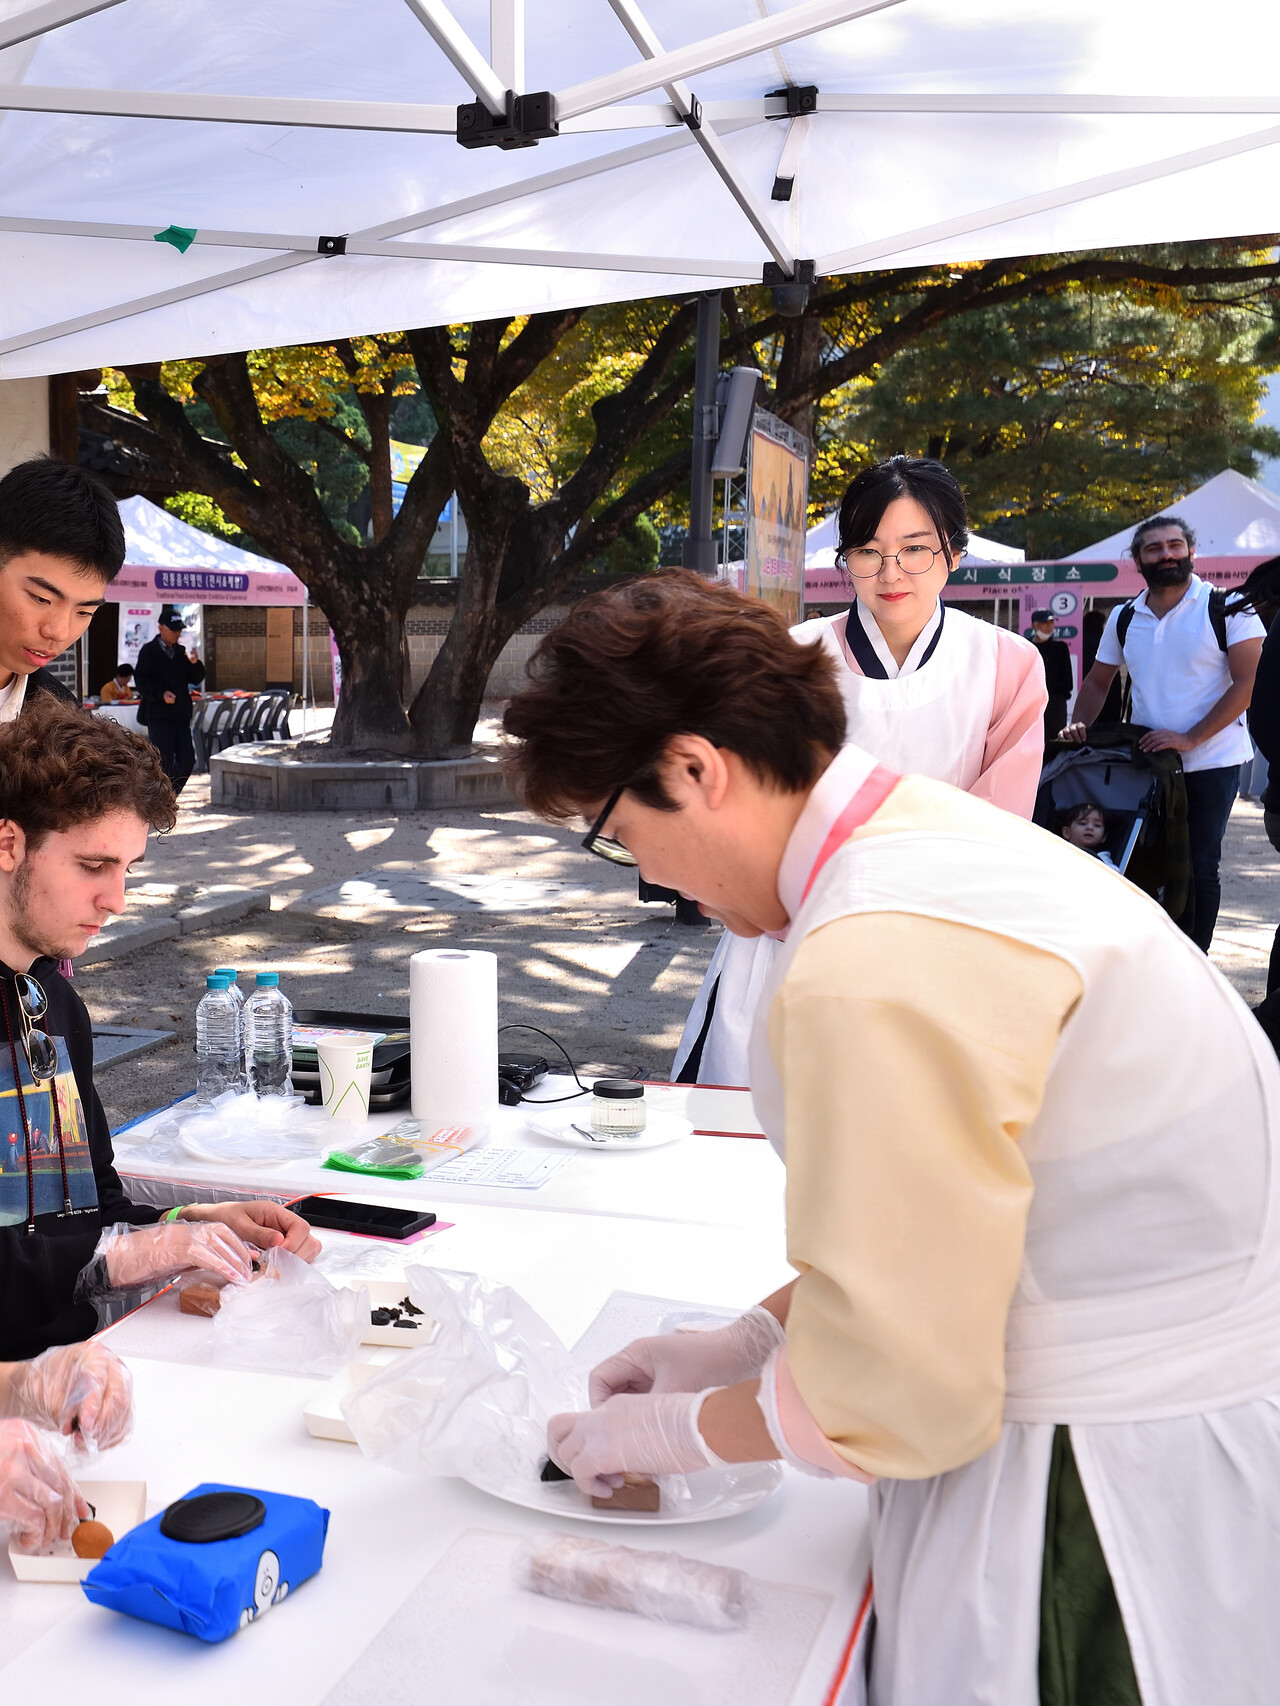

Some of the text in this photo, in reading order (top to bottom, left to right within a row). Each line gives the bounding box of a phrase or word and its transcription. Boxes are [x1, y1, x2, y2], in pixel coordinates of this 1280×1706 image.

[982, 586, 1008, 595] Place
[1059, 596, 1068, 610] 3
[356, 1055, 370, 1063] SAVE
